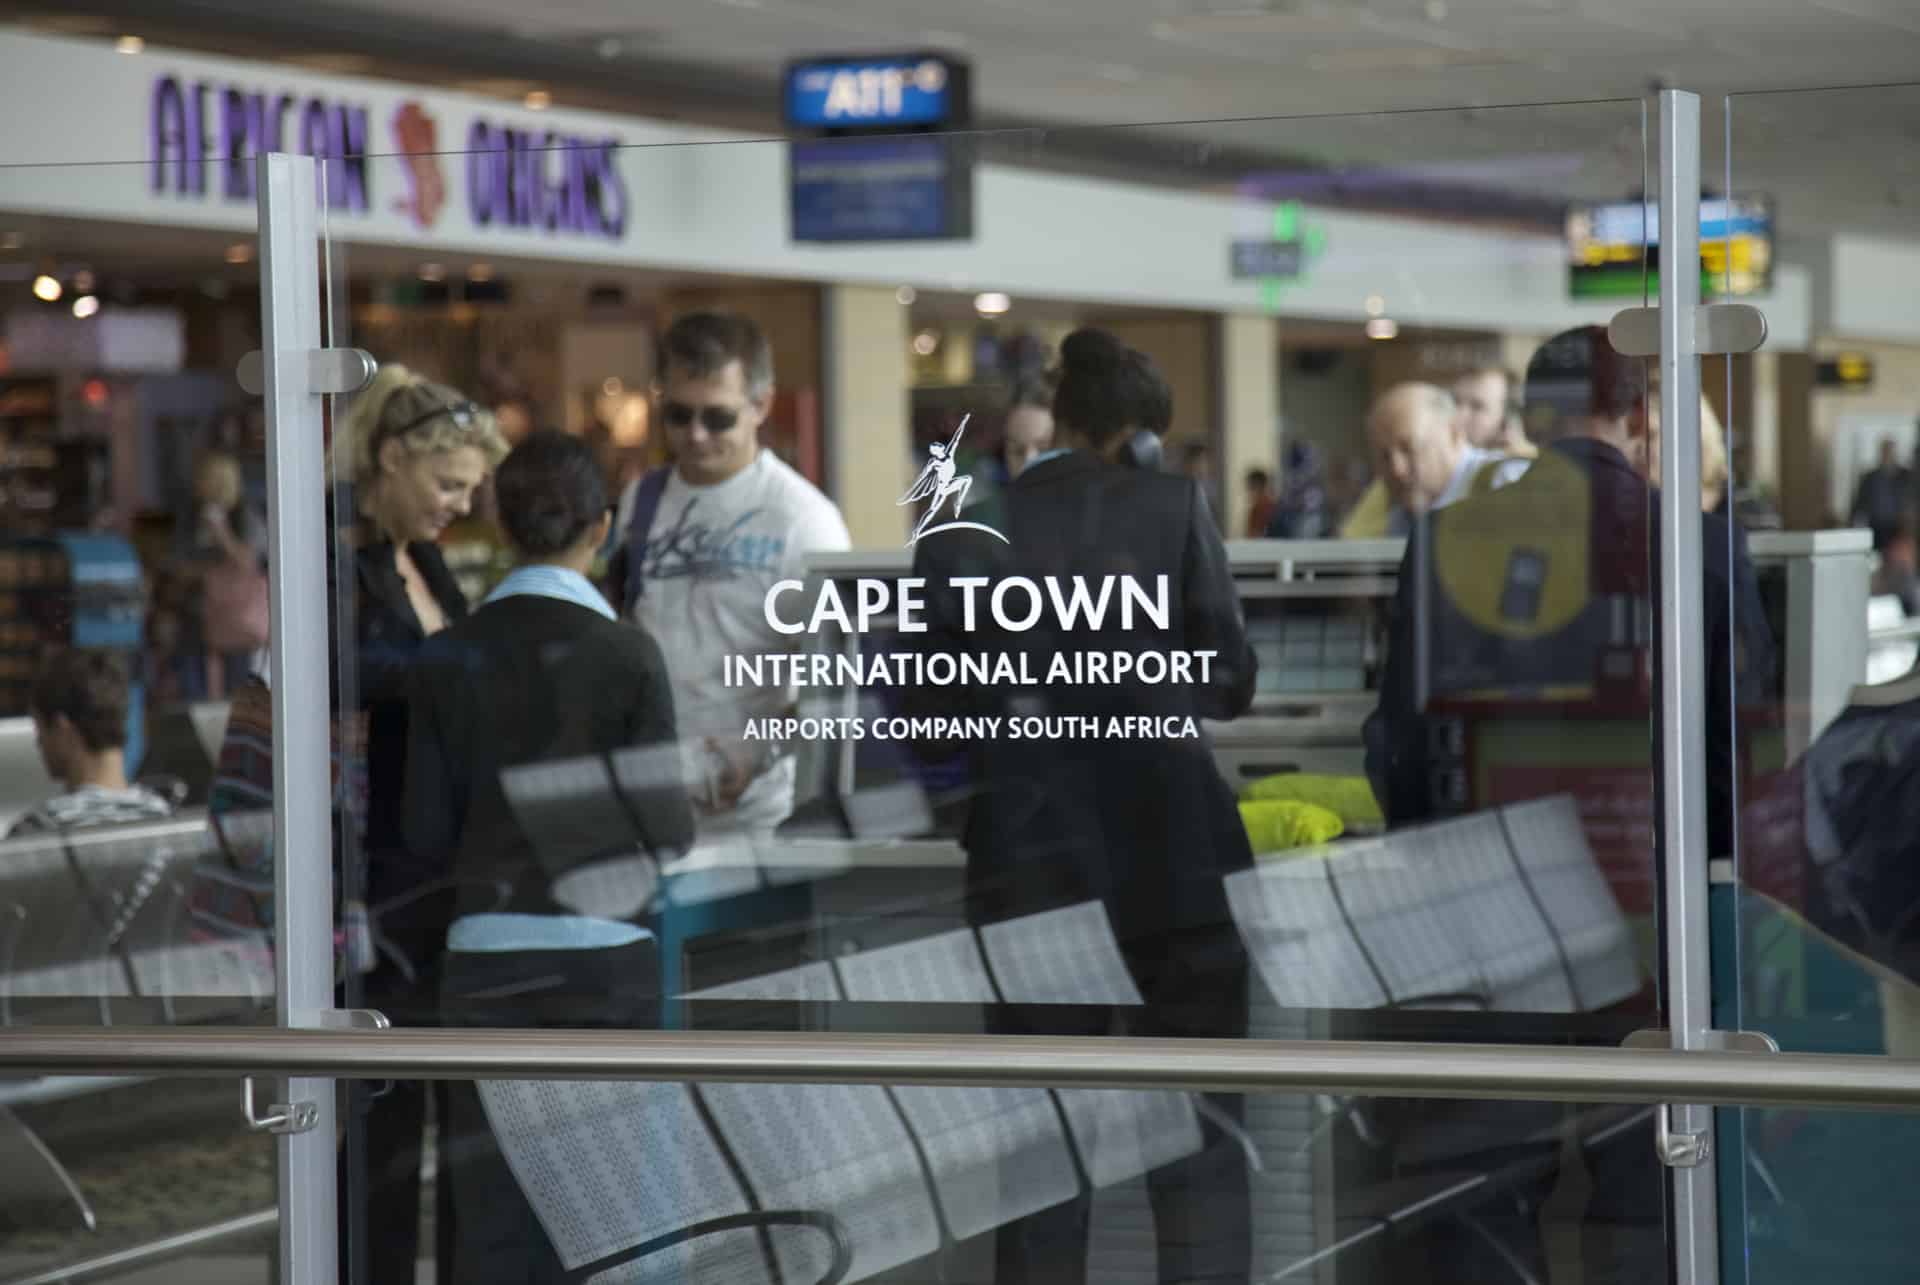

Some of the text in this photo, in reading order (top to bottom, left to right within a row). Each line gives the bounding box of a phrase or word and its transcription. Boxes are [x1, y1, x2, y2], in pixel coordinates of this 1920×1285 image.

[763, 574, 1170, 635] CAPE TOWN
[723, 650, 1218, 688] INTERNATIONAL AIRPORT
[743, 715, 1200, 741] AIRPORTS COMPANY SOUTH AFRICA
